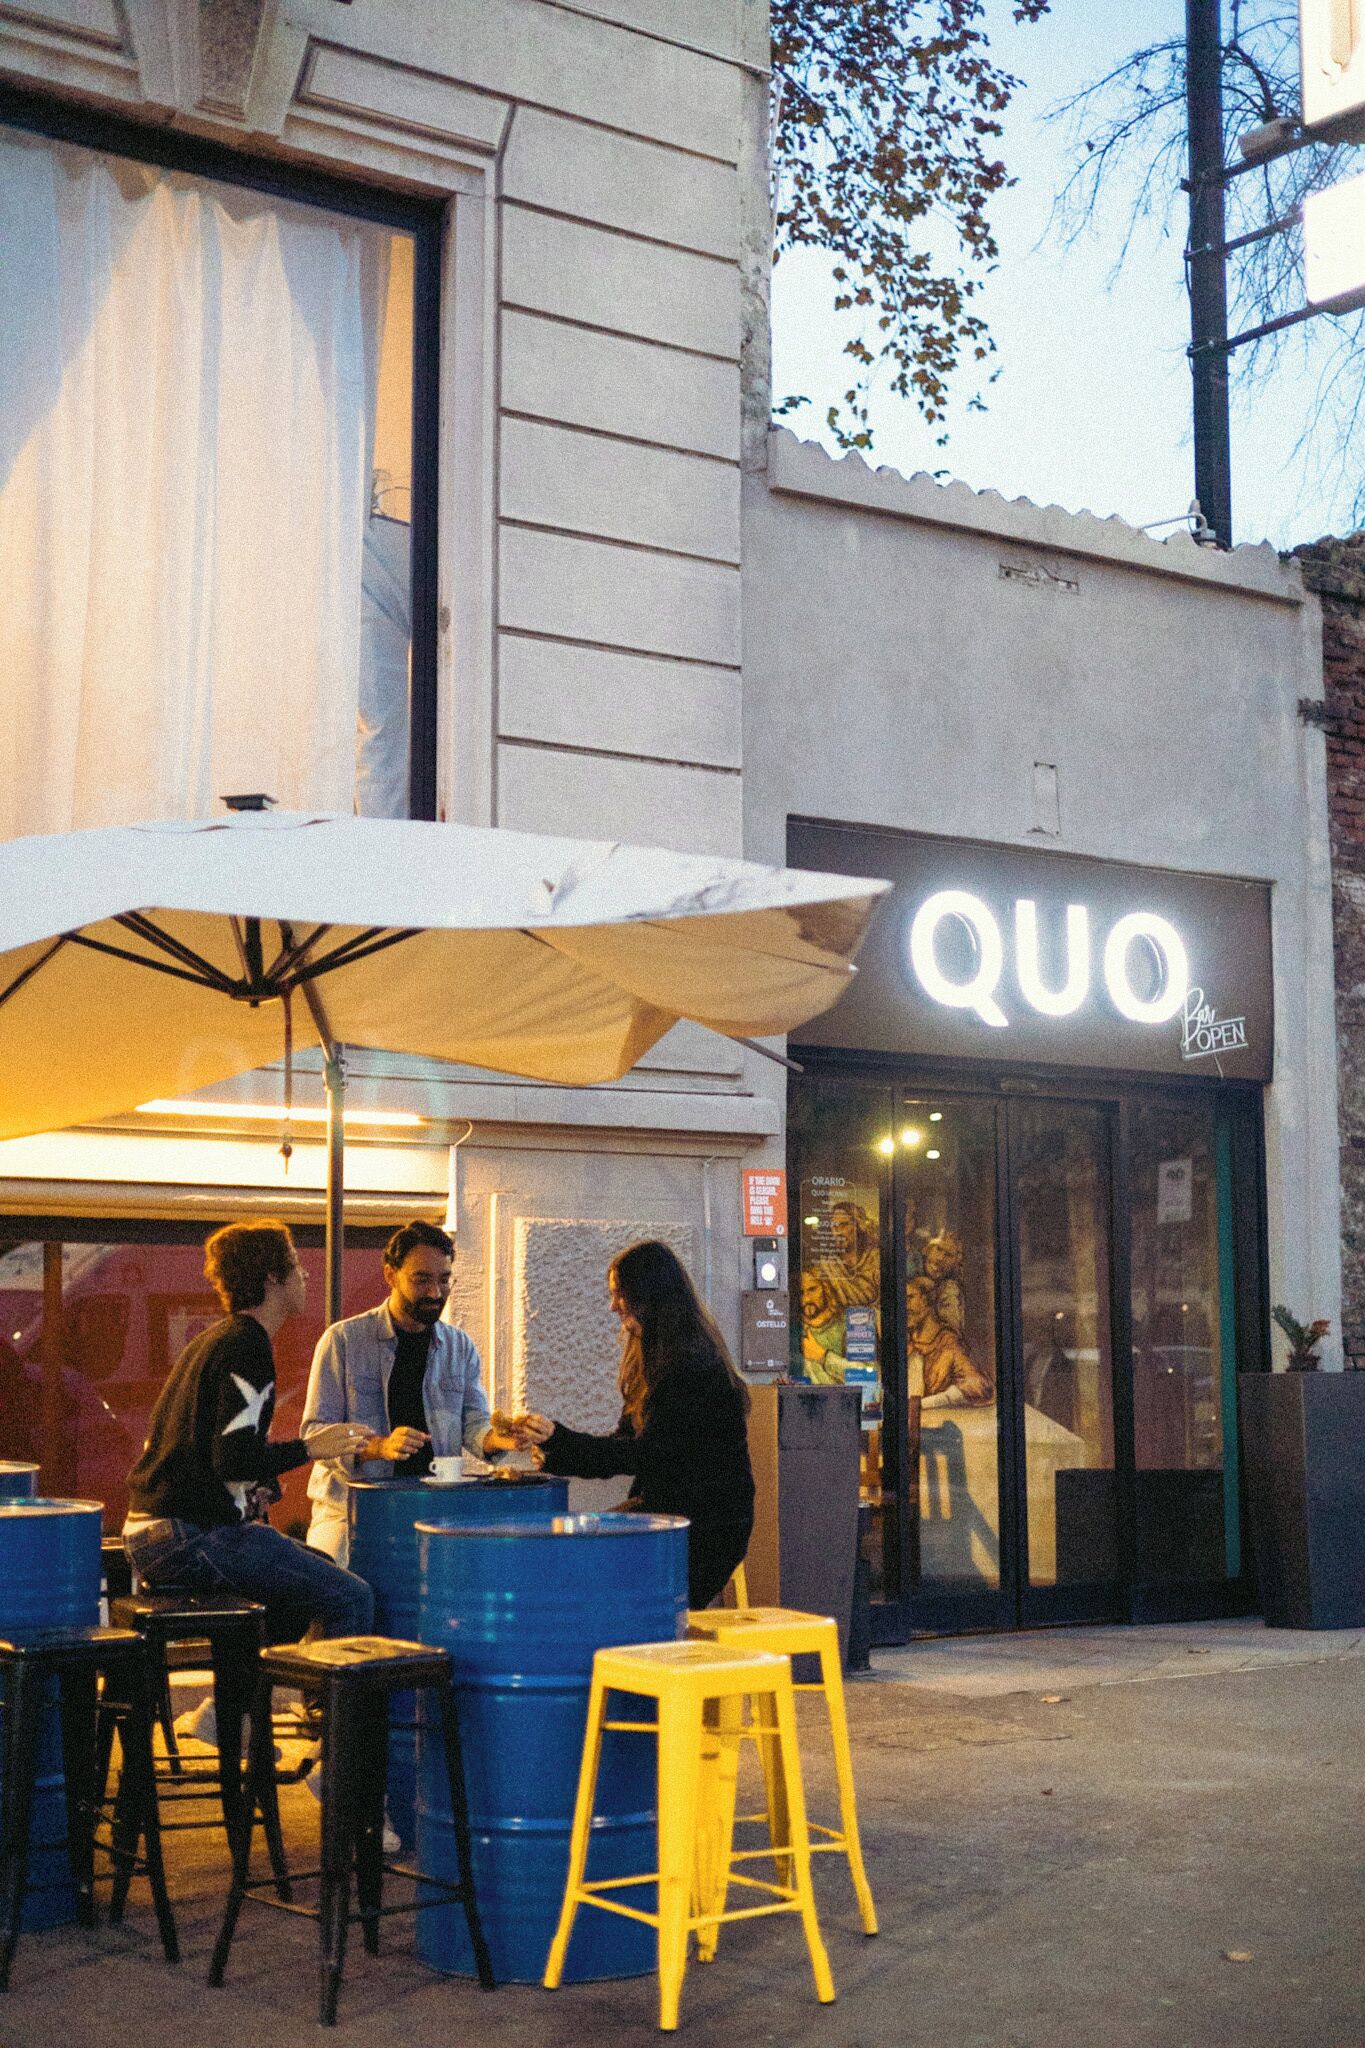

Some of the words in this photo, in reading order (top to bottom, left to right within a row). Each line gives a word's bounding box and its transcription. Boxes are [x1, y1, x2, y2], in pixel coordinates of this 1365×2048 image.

[910, 889, 1190, 1028] QUO
[1182, 987, 1217, 1051] Bar
[1195, 1021, 1246, 1051] OPEN
[811, 1176, 845, 1187] ORARIO
[756, 1320, 787, 1328] OSTELLO
